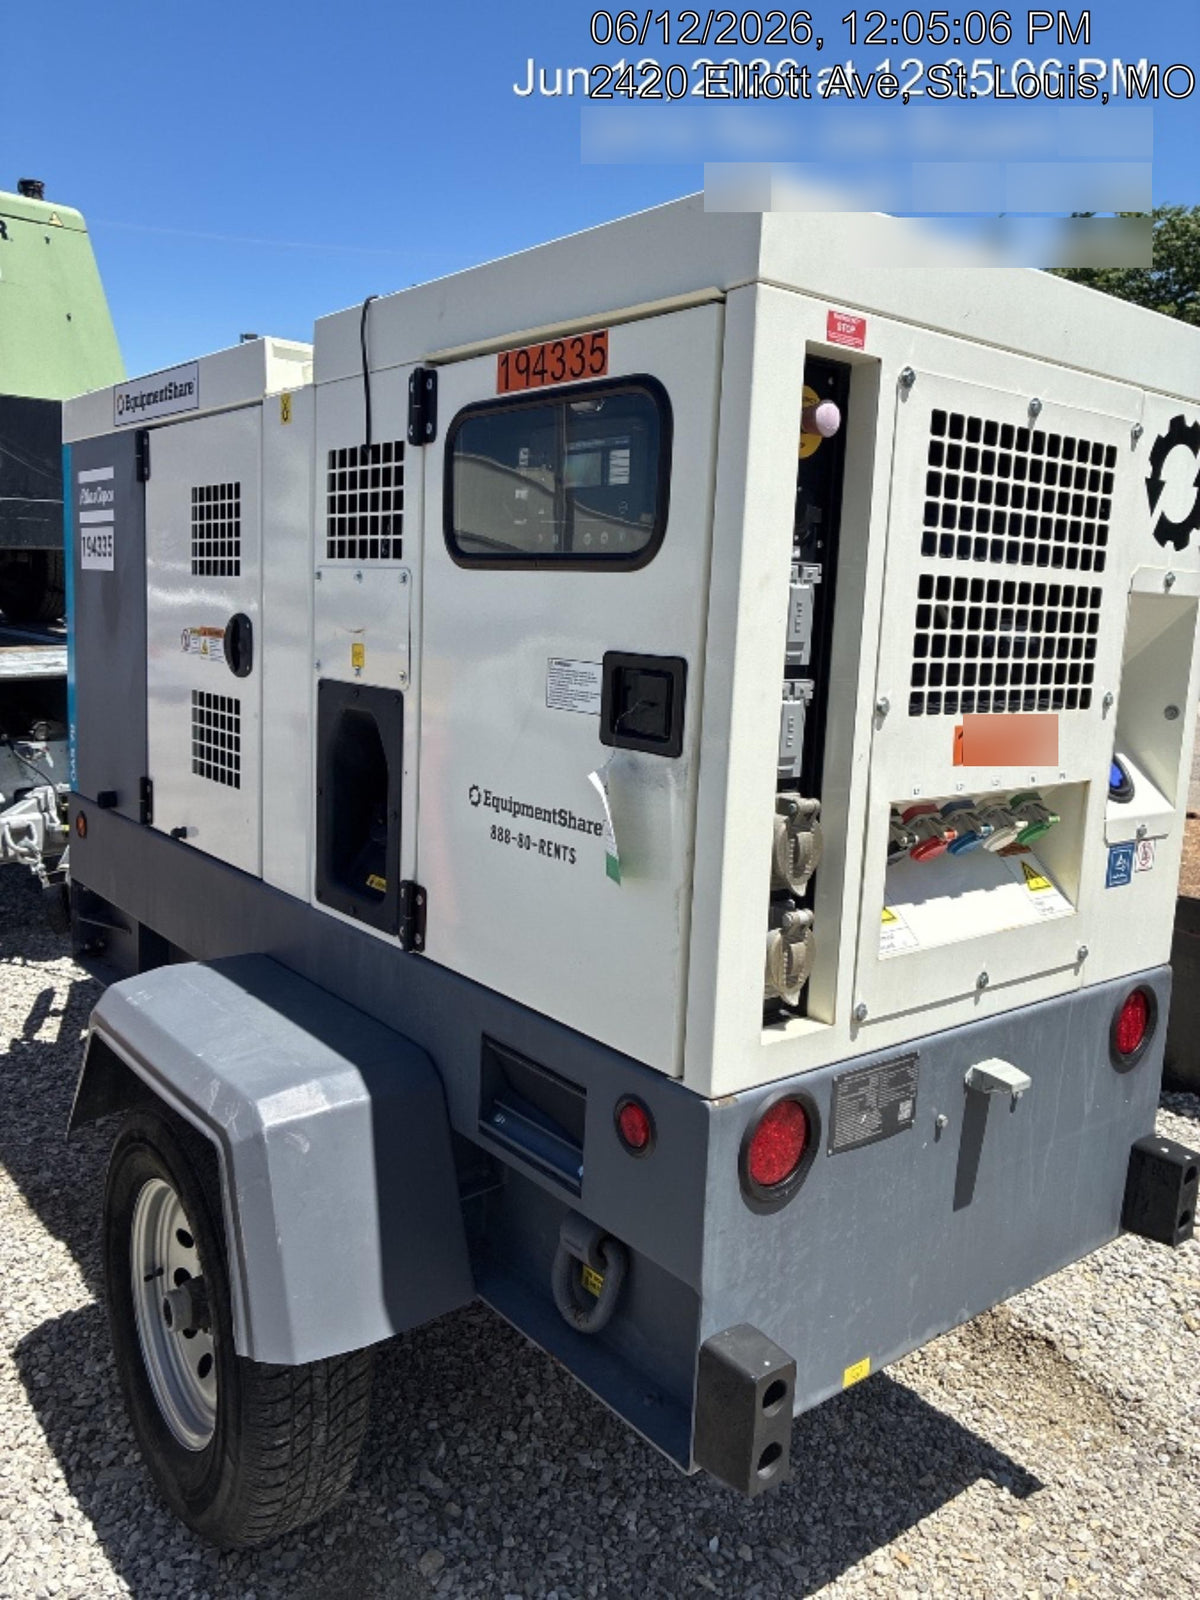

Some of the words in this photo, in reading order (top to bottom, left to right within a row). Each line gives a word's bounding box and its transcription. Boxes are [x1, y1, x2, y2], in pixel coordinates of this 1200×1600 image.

[500, 331, 606, 390] 194335
[125, 381, 194, 413] EquipmentShare
[82, 534, 113, 558] 194335
[483, 789, 603, 837] EquipmentShare
[490, 824, 577, 864] 888-80-RENTS
